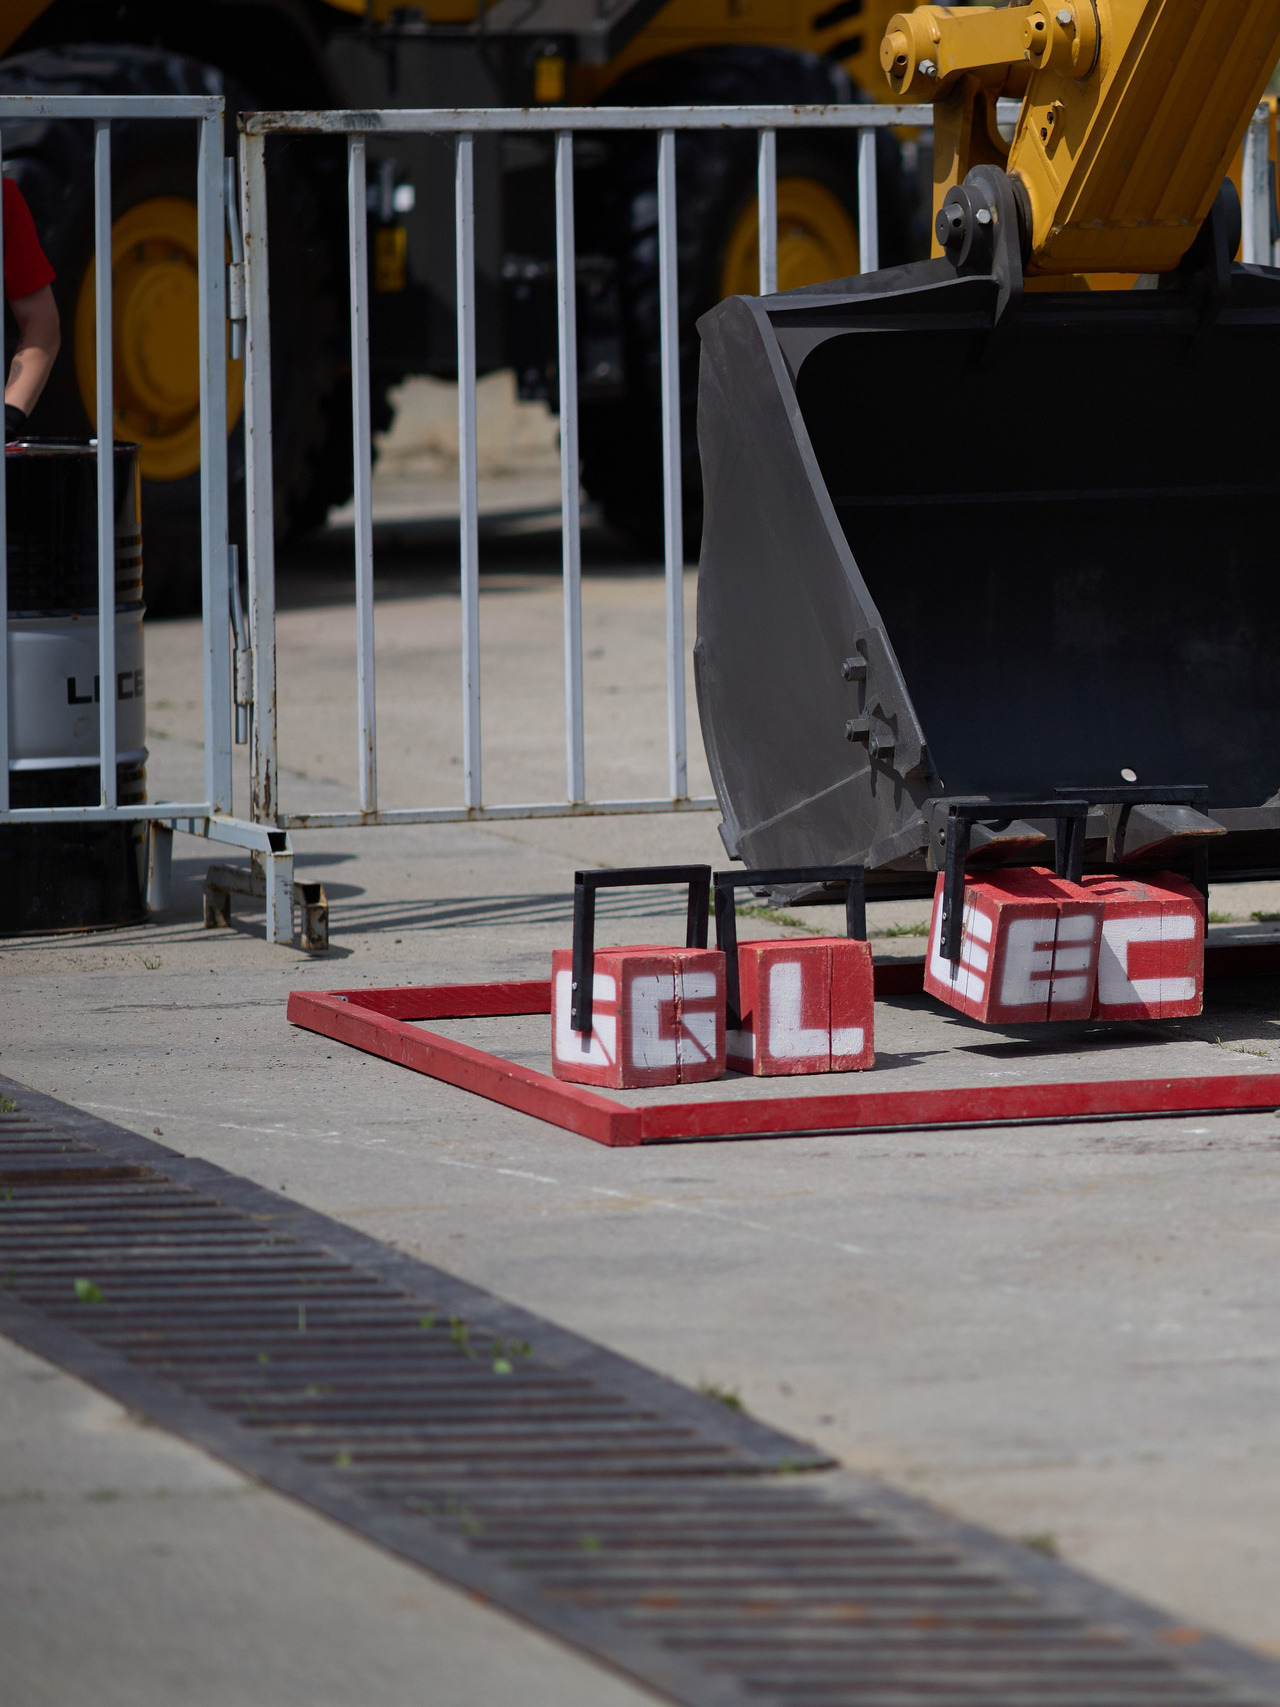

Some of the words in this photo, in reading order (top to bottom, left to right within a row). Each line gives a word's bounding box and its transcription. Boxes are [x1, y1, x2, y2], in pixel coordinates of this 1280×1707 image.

[1001, 914, 1096, 1007] E
[1098, 915, 1196, 1005] C
[631, 971, 717, 1069] G
[769, 962, 865, 1058] L
